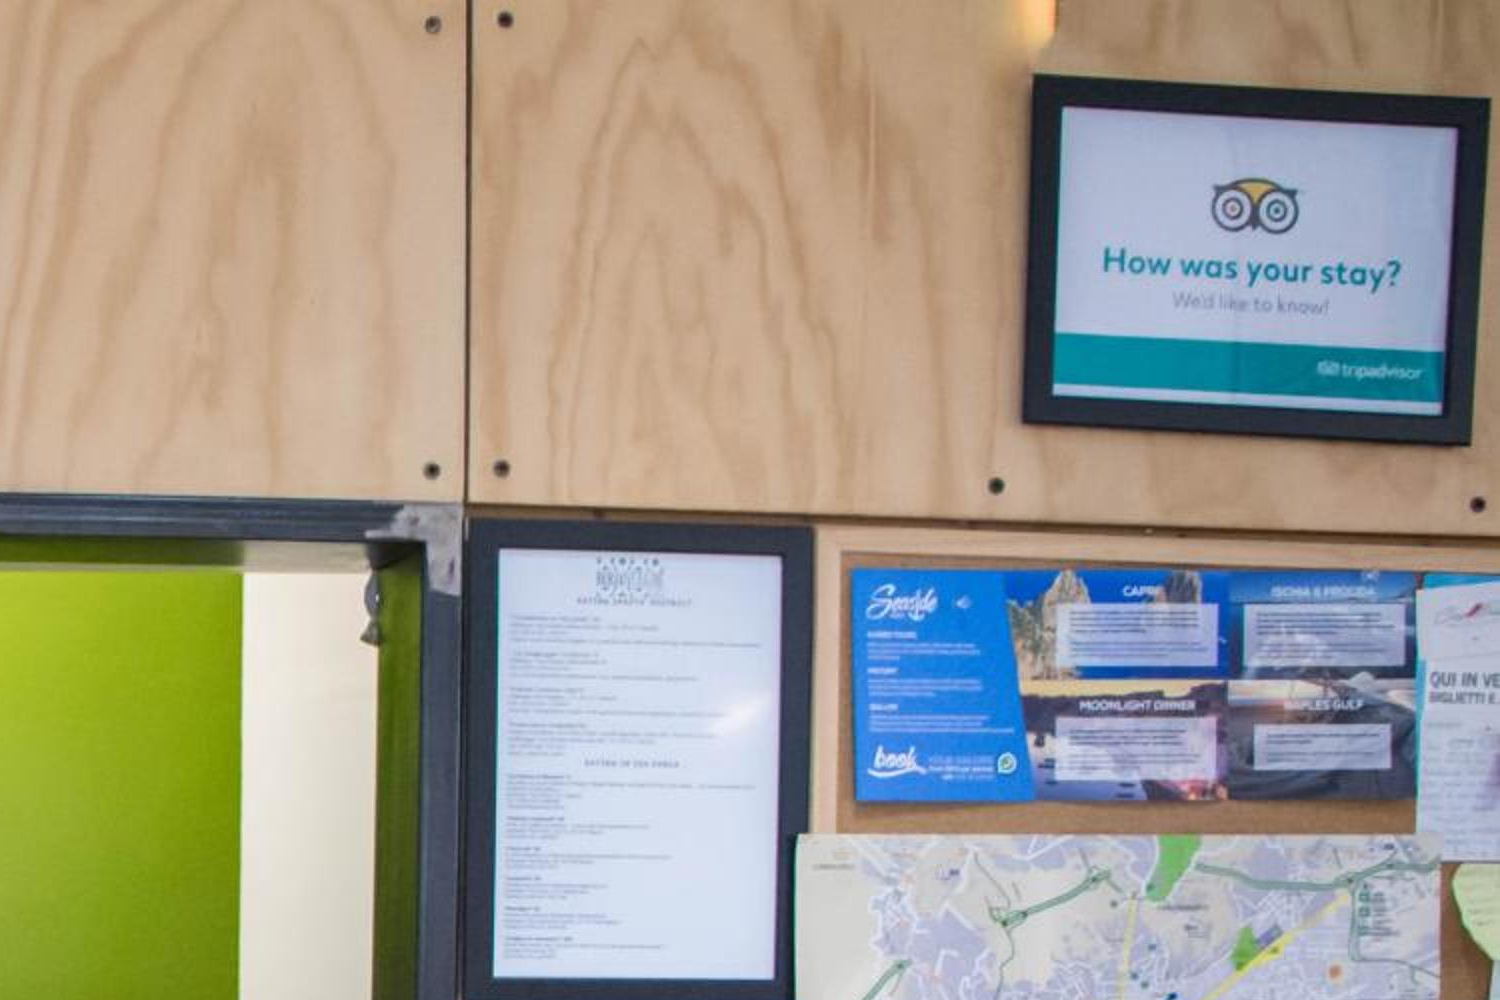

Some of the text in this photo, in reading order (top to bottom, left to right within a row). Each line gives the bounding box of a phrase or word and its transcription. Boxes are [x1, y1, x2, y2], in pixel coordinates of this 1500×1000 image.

[1102, 246, 1402, 294] How was your stay?
[1219, 294, 1247, 312] like
[1253, 297, 1272, 313] to
[1277, 297, 1331, 316] know!
[1341, 362, 1423, 381] tripadvisor
[1429, 671, 1457, 688] QUI
[1461, 671, 1478, 687] IN
